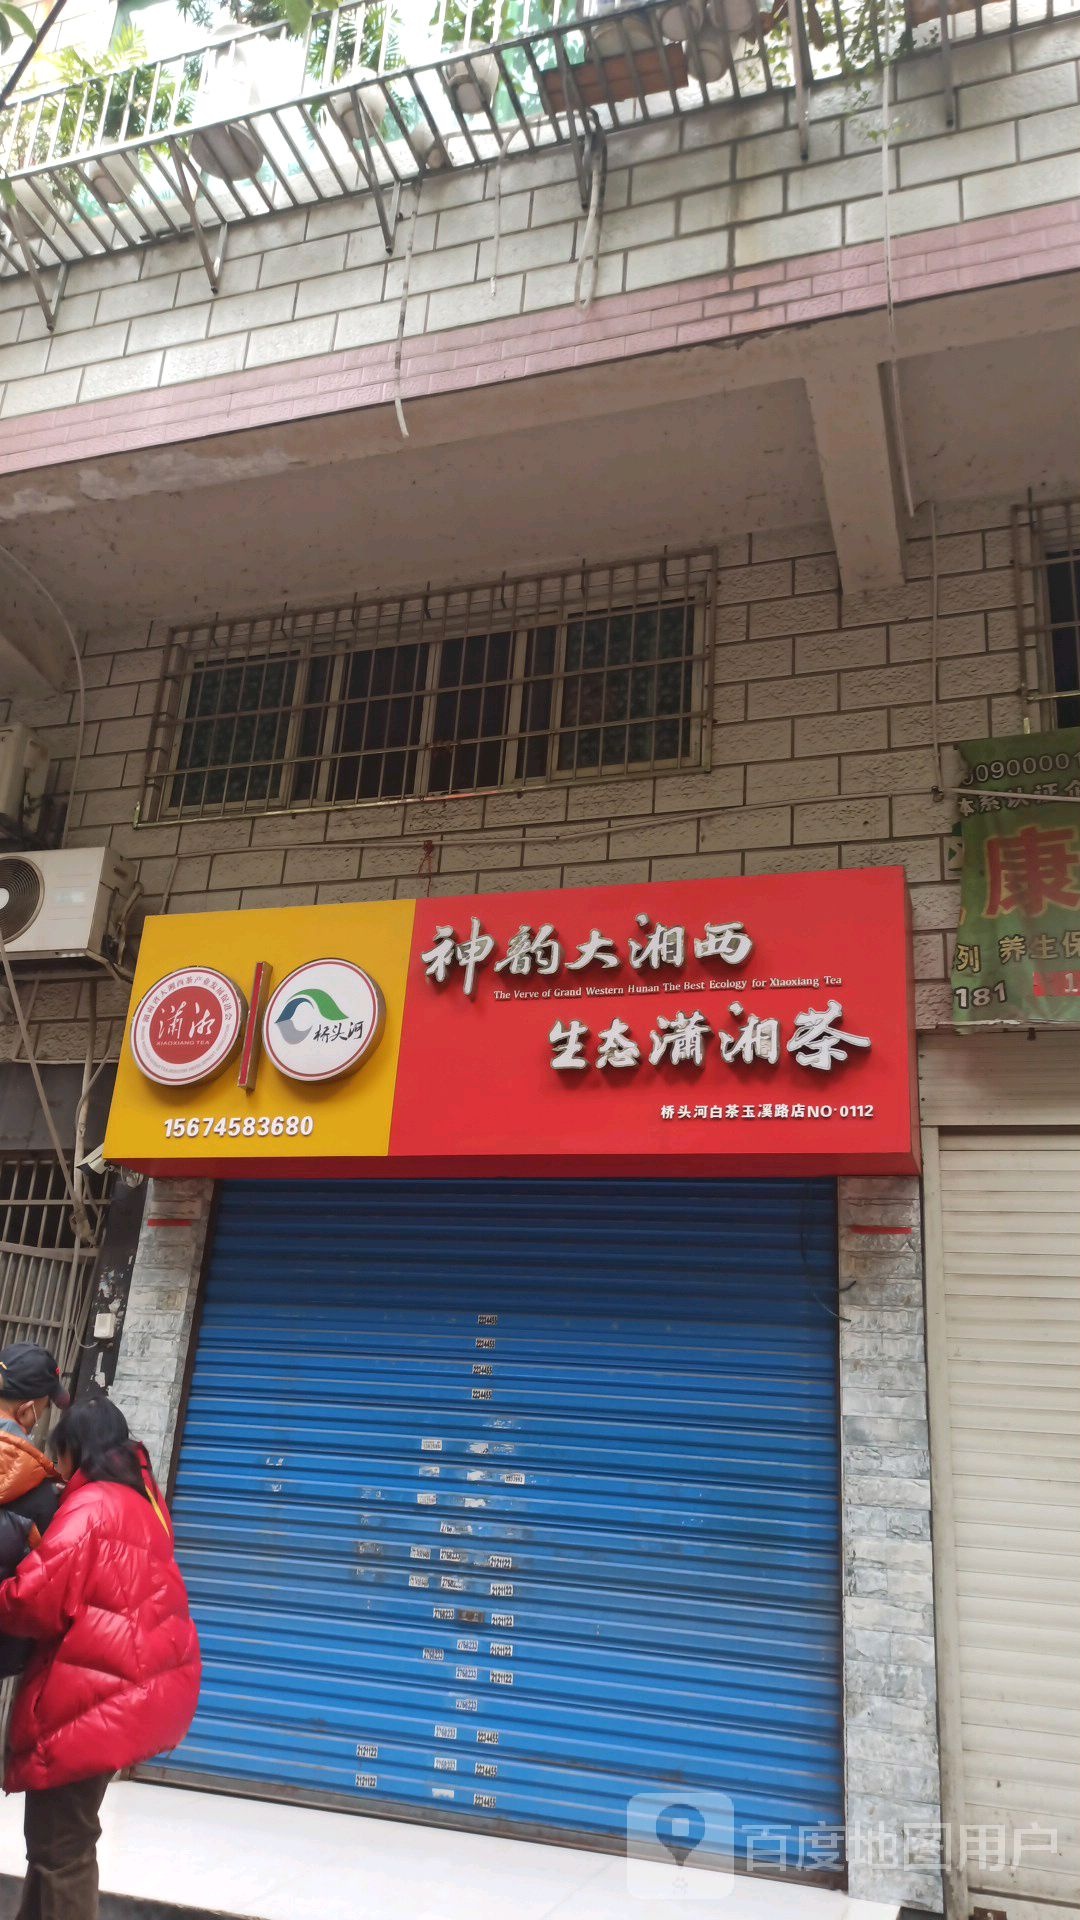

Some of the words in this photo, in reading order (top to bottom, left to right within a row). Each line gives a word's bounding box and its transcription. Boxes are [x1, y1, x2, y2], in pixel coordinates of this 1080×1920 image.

[982, 825, 1080, 918] 康
[421, 912, 753, 996] 神韵大湘西
[494, 990, 511, 999] The
[514, 989, 539, 999] Verve
[541, 989, 551, 998] of
[554, 987, 582, 997] Grand
[586, 986, 624, 995] Western
[628, 984, 660, 993] Hunan
[663, 982, 681, 991] The
[684, 981, 706, 990] Best
[709, 979, 748, 989] Ecology
[752, 978, 766, 987] for
[824, 975, 843, 985] Tea
[955, 982, 1006, 1008] 181
[313, 1020, 364, 1042] 桥头河
[549, 1000, 871, 1070] 生态潇湘茶
[163, 1115, 314, 1138] 15674583680
